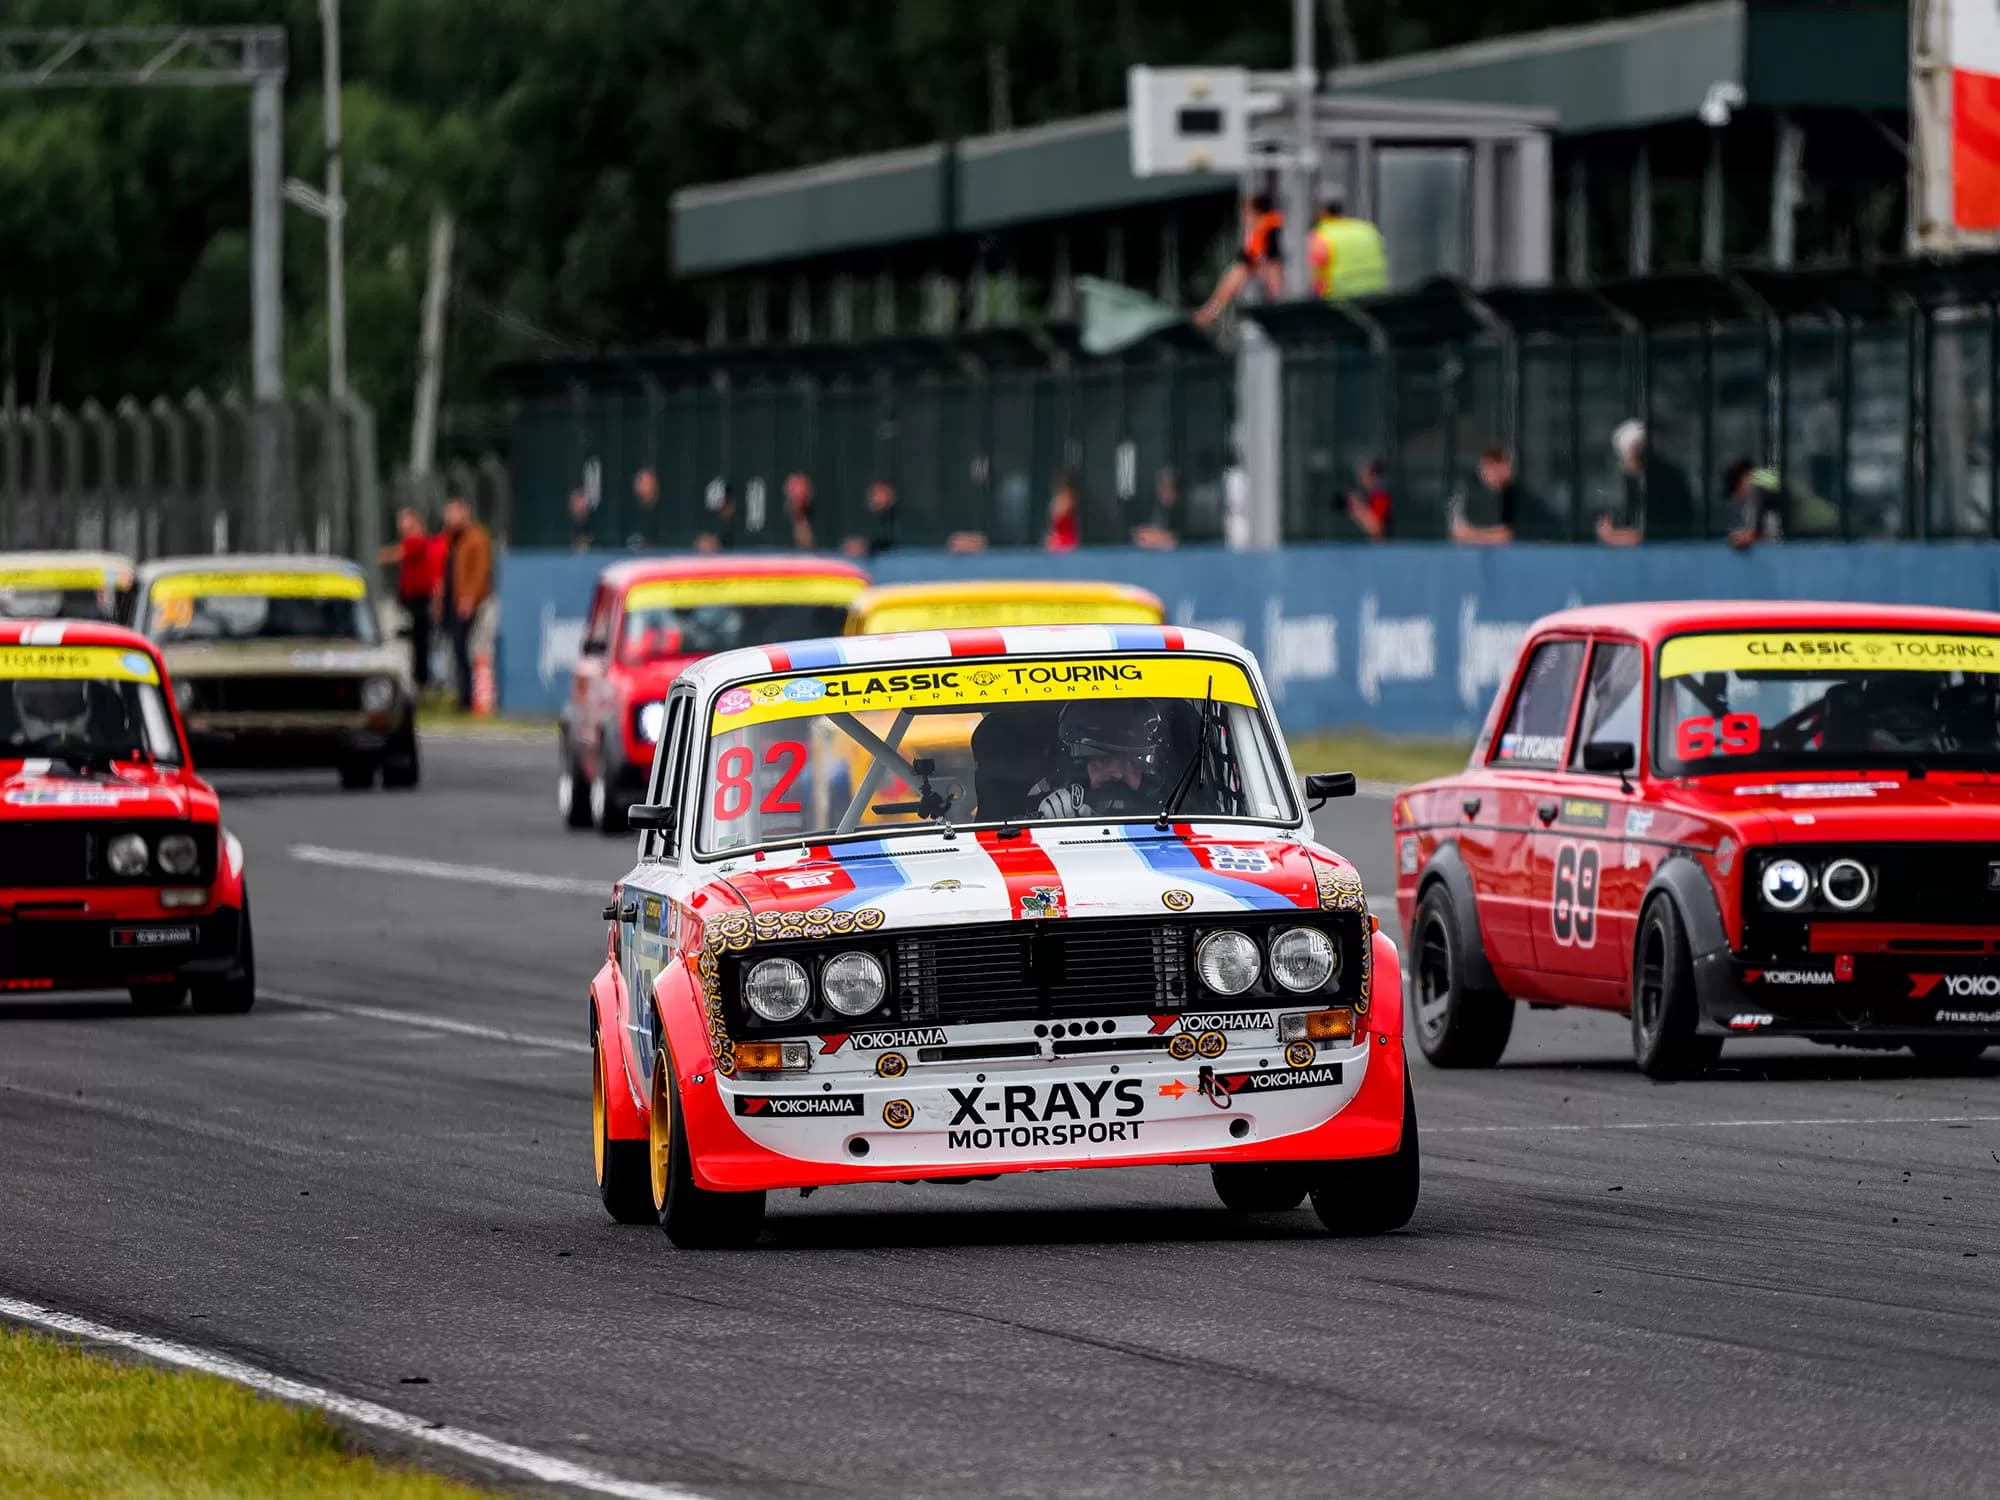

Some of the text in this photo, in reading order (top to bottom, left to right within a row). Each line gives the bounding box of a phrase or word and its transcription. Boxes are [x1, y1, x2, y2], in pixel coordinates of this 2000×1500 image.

[1746, 640, 1995, 658] CLASSIC TOURING
[825, 664, 1143, 697] CLASSIC TOURING
[843, 684, 1124, 706] INTERNATIONAL
[1676, 711, 1761, 762] 69
[714, 741, 807, 822] 82
[1553, 839, 1600, 948] 69
[1763, 970, 1835, 985] YOKOHAMA
[1180, 1013, 1273, 1030] YOKOHAMA
[850, 1029, 946, 1049] YOKOHAMA
[1251, 1069, 1334, 1088] YOKOHAMA
[769, 1099, 855, 1113] YOKOHAMA
[947, 1079, 1145, 1126] X-RAYS
[949, 1120, 1145, 1149] MOTORSPORT
